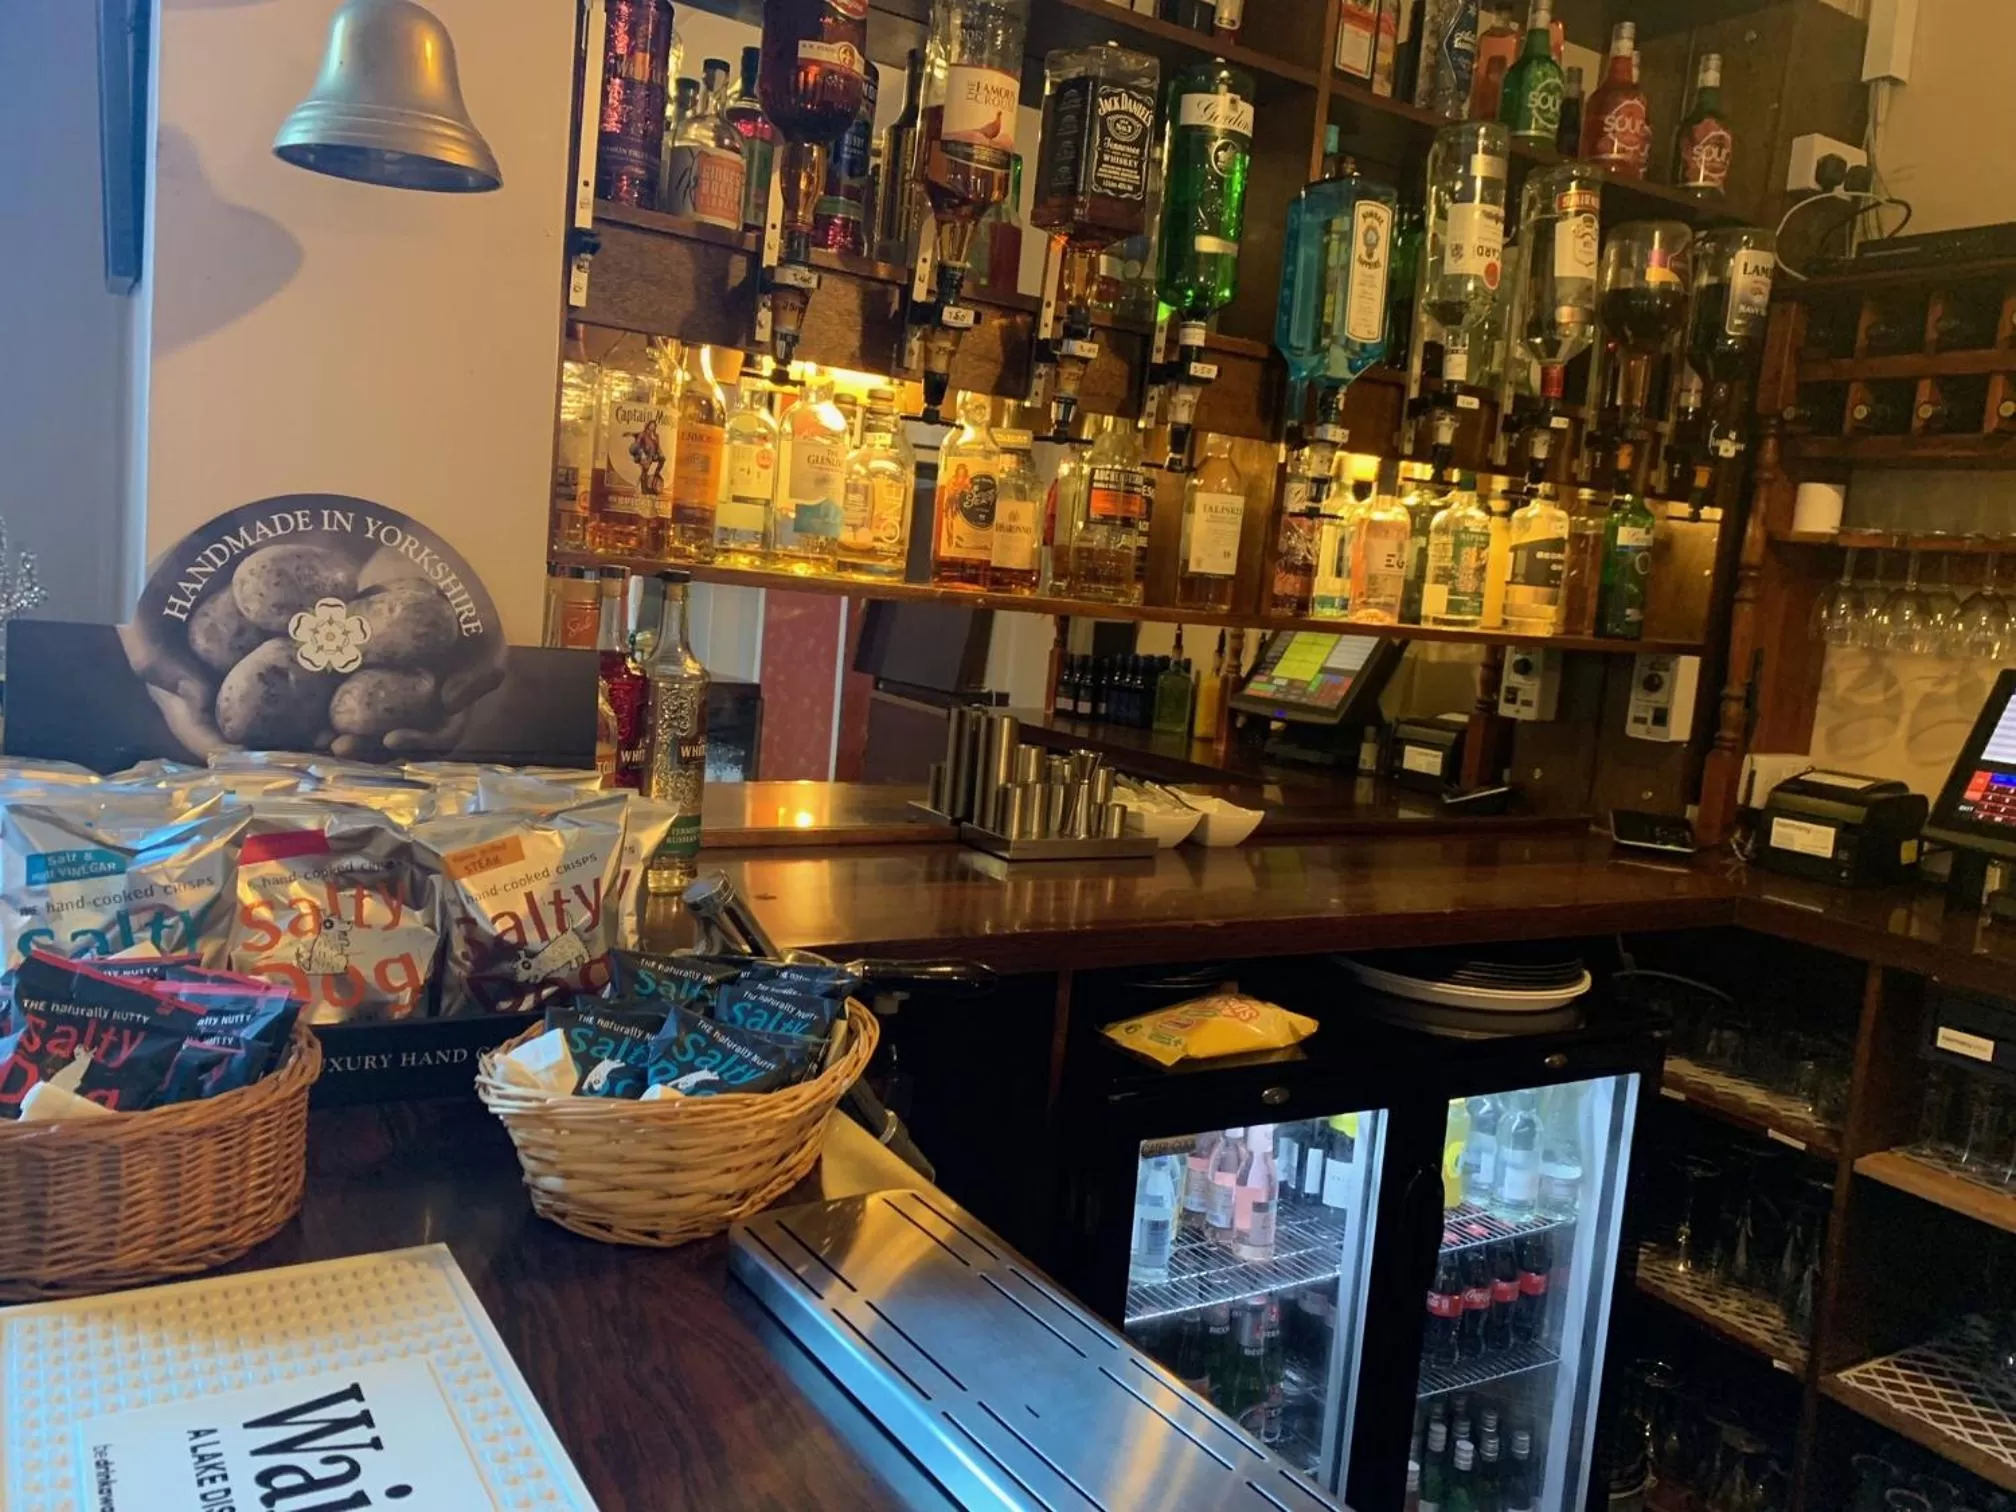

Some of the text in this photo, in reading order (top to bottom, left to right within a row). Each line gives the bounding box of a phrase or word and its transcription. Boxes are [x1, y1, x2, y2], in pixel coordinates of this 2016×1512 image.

[615, 405, 653, 424] Captain
[163, 509, 485, 638] HANDMADE IN YORKSHIRE
[59, 862, 118, 878] VINEGAR
[463, 855, 502, 875] STEAK
[23, 998, 150, 1026] THE naturally NUTTY
[578, 1014, 595, 1026] THE
[596, 1017, 643, 1039] naturally
[19, 1015, 146, 1069] Salty
[697, 1019, 713, 1033] THE
[712, 1029, 753, 1061] naturally
[323, 1053, 393, 1073] XURY
[401, 1047, 469, 1068] HAND
[187, 1428, 218, 1441] A
[189, 1440, 229, 1488] LAKE
